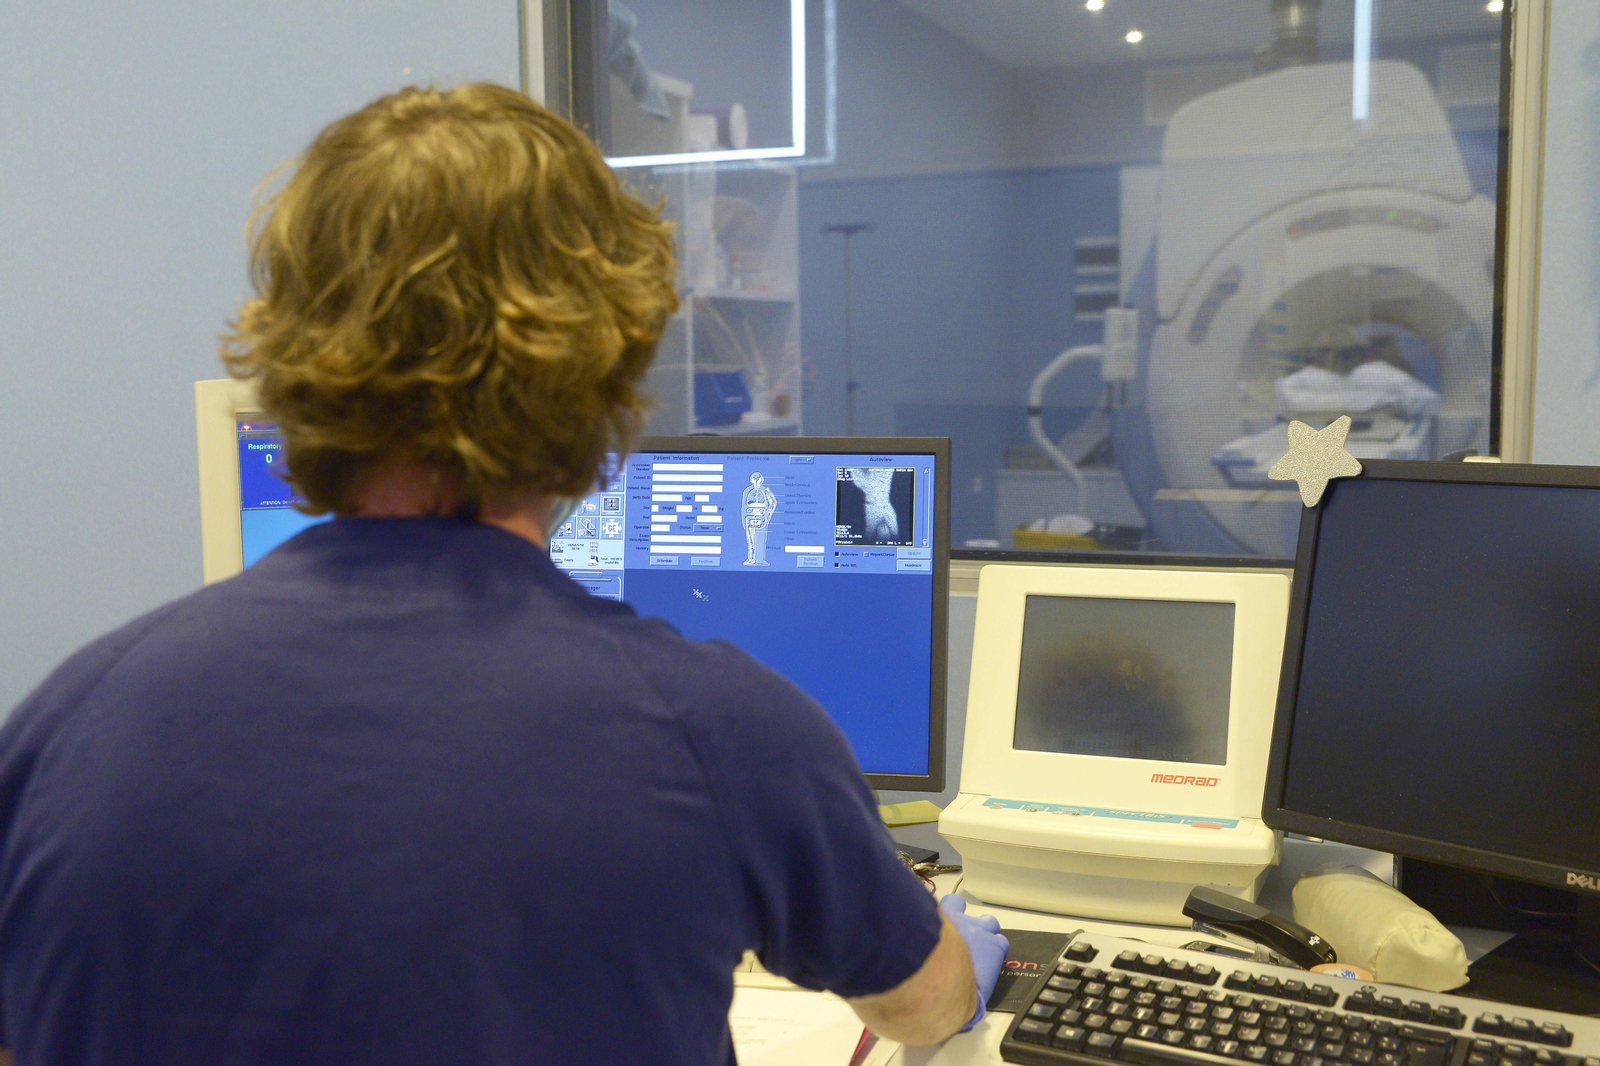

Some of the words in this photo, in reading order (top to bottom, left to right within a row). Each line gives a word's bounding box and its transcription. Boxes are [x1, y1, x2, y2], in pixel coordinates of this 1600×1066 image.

[266, 454, 272, 463] 0
[1150, 774, 1218, 787] MEDRAD
[1004, 960, 1048, 970] ons
